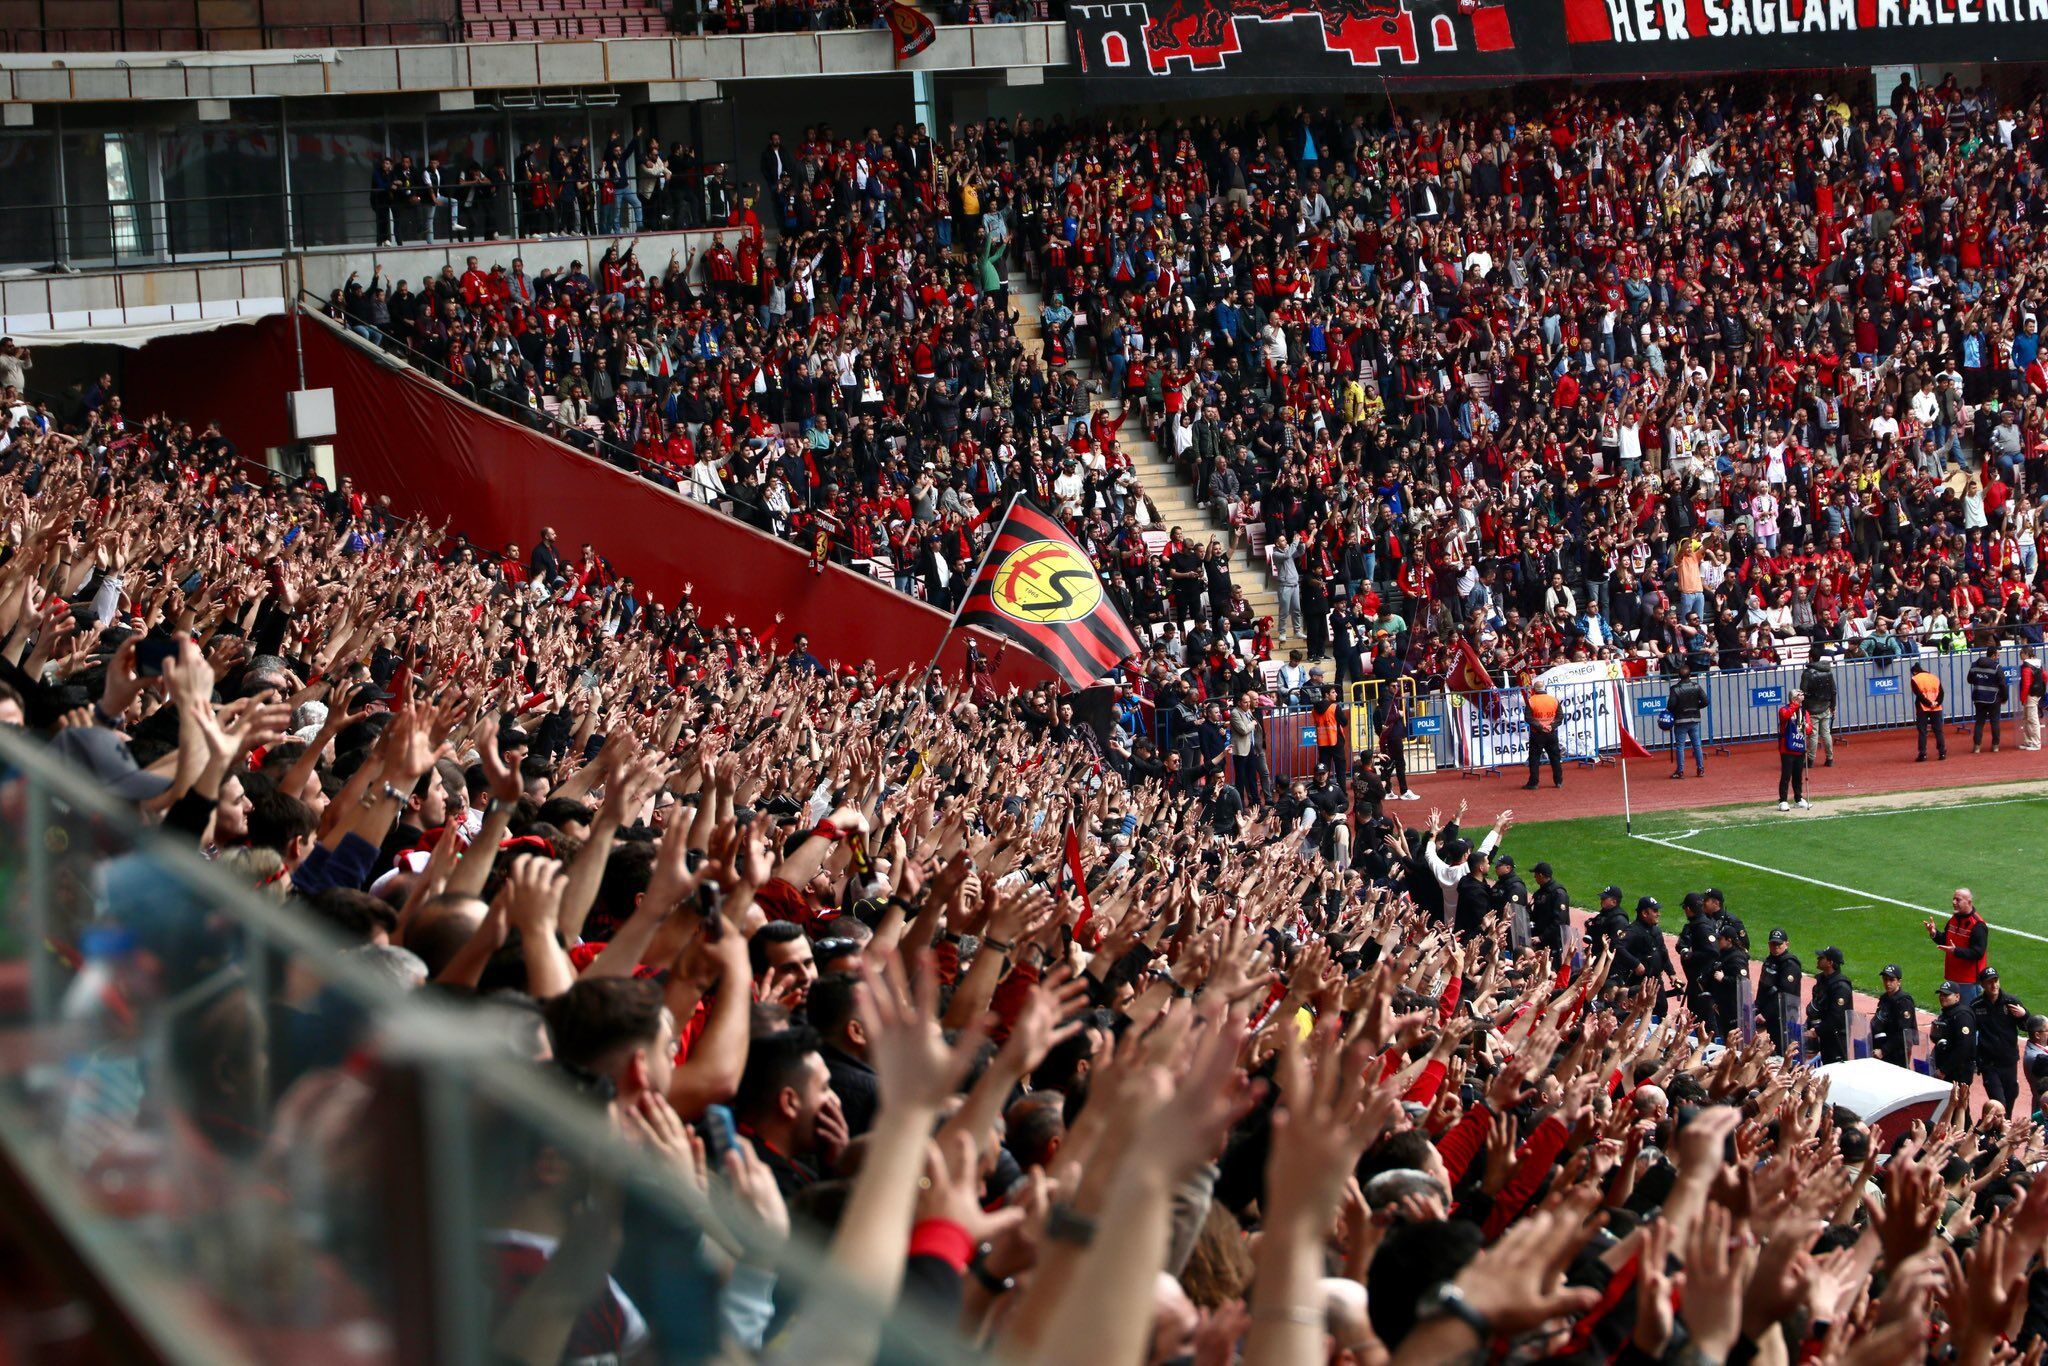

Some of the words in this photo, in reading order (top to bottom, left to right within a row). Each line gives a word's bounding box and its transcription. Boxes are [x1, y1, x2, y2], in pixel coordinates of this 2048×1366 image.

[1608, 0, 1689, 42] HER
[2003, 667, 2018, 677] OLİS
[1875, 679, 1893, 687] POLİS
[1758, 690, 1776, 698] POLİS
[1643, 700, 1661, 708] POLİS
[1417, 719, 1435, 728] POLİS
